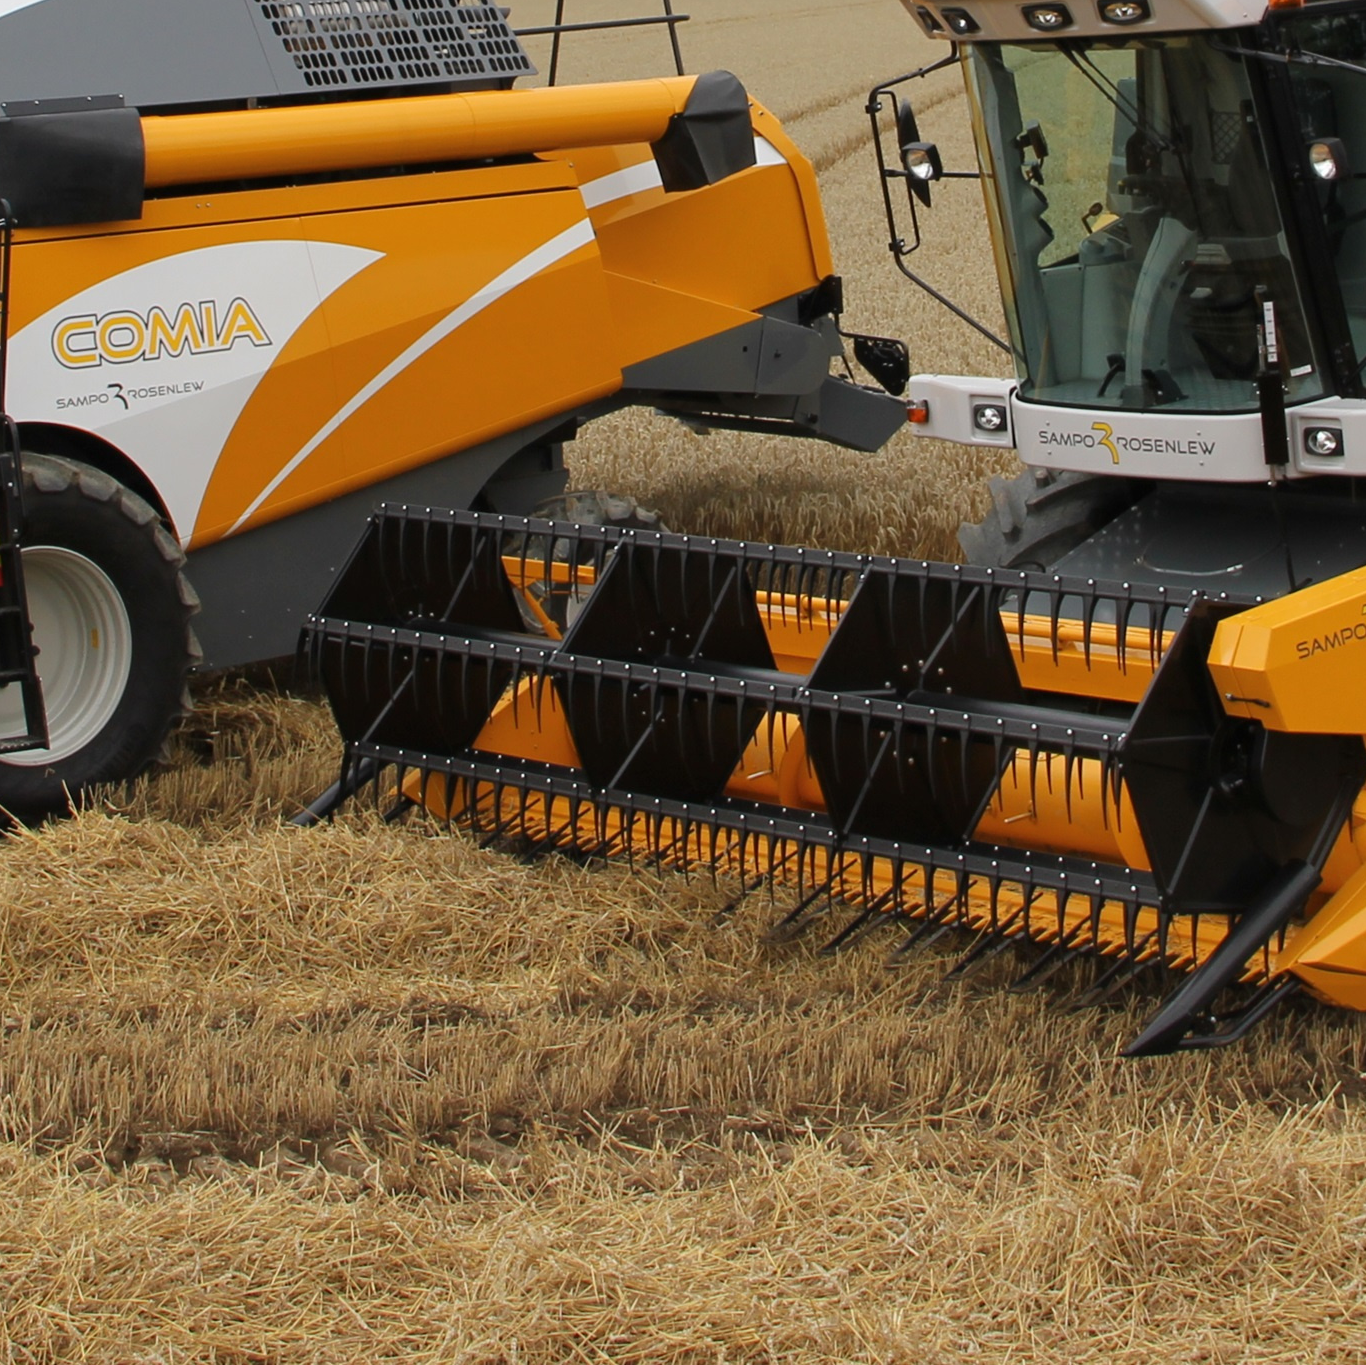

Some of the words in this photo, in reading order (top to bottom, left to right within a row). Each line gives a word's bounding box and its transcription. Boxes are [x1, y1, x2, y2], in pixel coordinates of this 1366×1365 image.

[51, 296, 273, 369] COMIA
[55, 392, 110, 410] SAMPO
[126, 380, 205, 400] ROSENLEW
[1038, 430, 1096, 449] SAMPO
[1116, 436, 1216, 455] ROSENLEW
